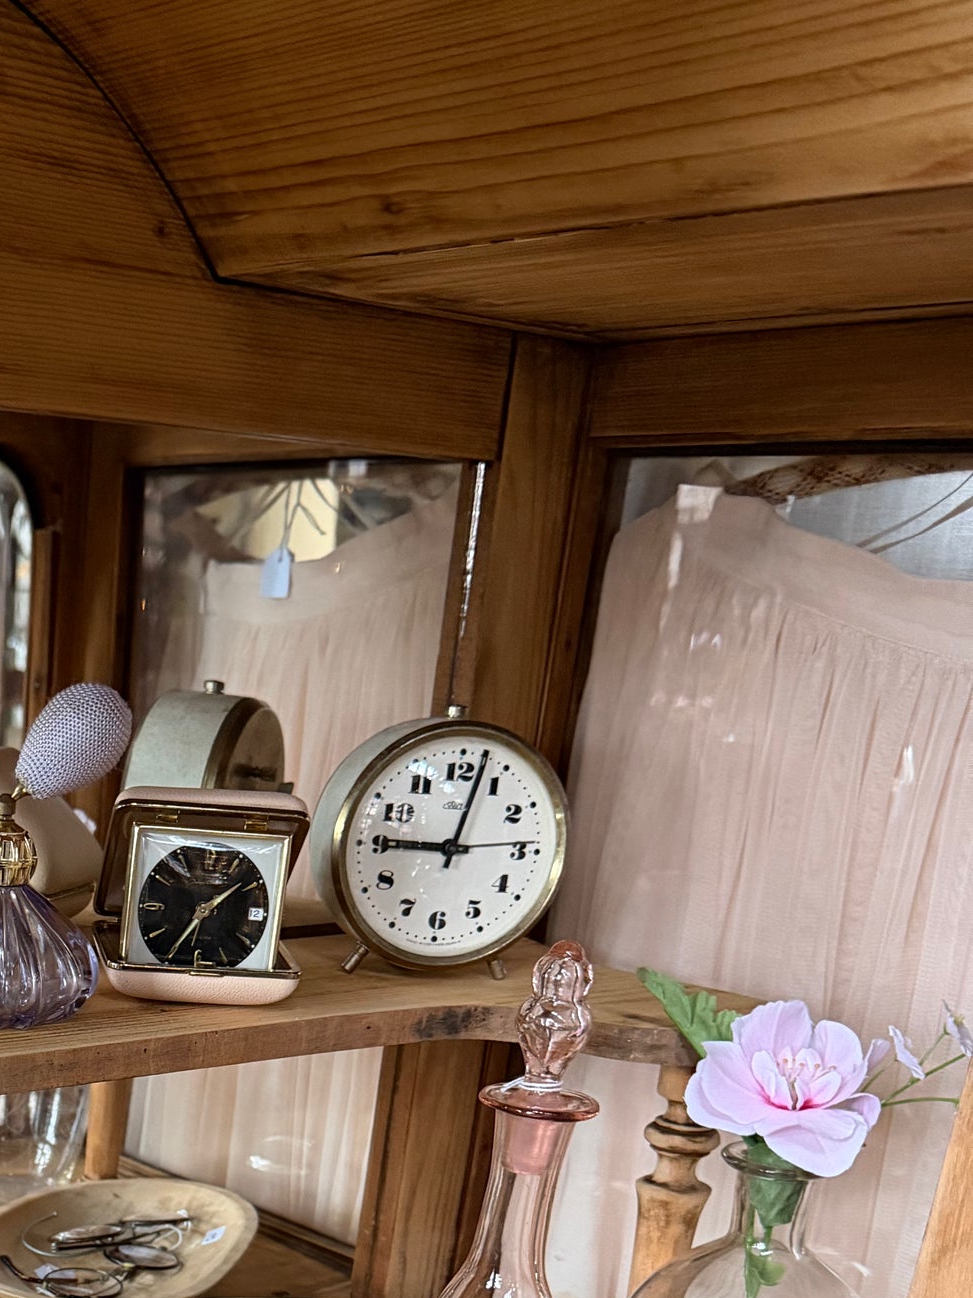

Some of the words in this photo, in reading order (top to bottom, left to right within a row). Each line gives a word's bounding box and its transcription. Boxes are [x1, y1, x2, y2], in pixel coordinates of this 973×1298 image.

[445, 762, 475, 782] 12
[408, 775, 432, 795] 11
[487, 776, 500, 796] 1
[382, 803, 414, 823] 10
[503, 804, 522, 824] 2
[372, 834, 390, 854] 9
[510, 842, 527, 860] 3
[376, 870, 394, 890] 8
[491, 874, 510, 893] 4
[249, 909, 260, 918] 12
[399, 898, 416, 917] 7
[465, 900, 482, 919] 5
[428, 911, 446, 930] 6
